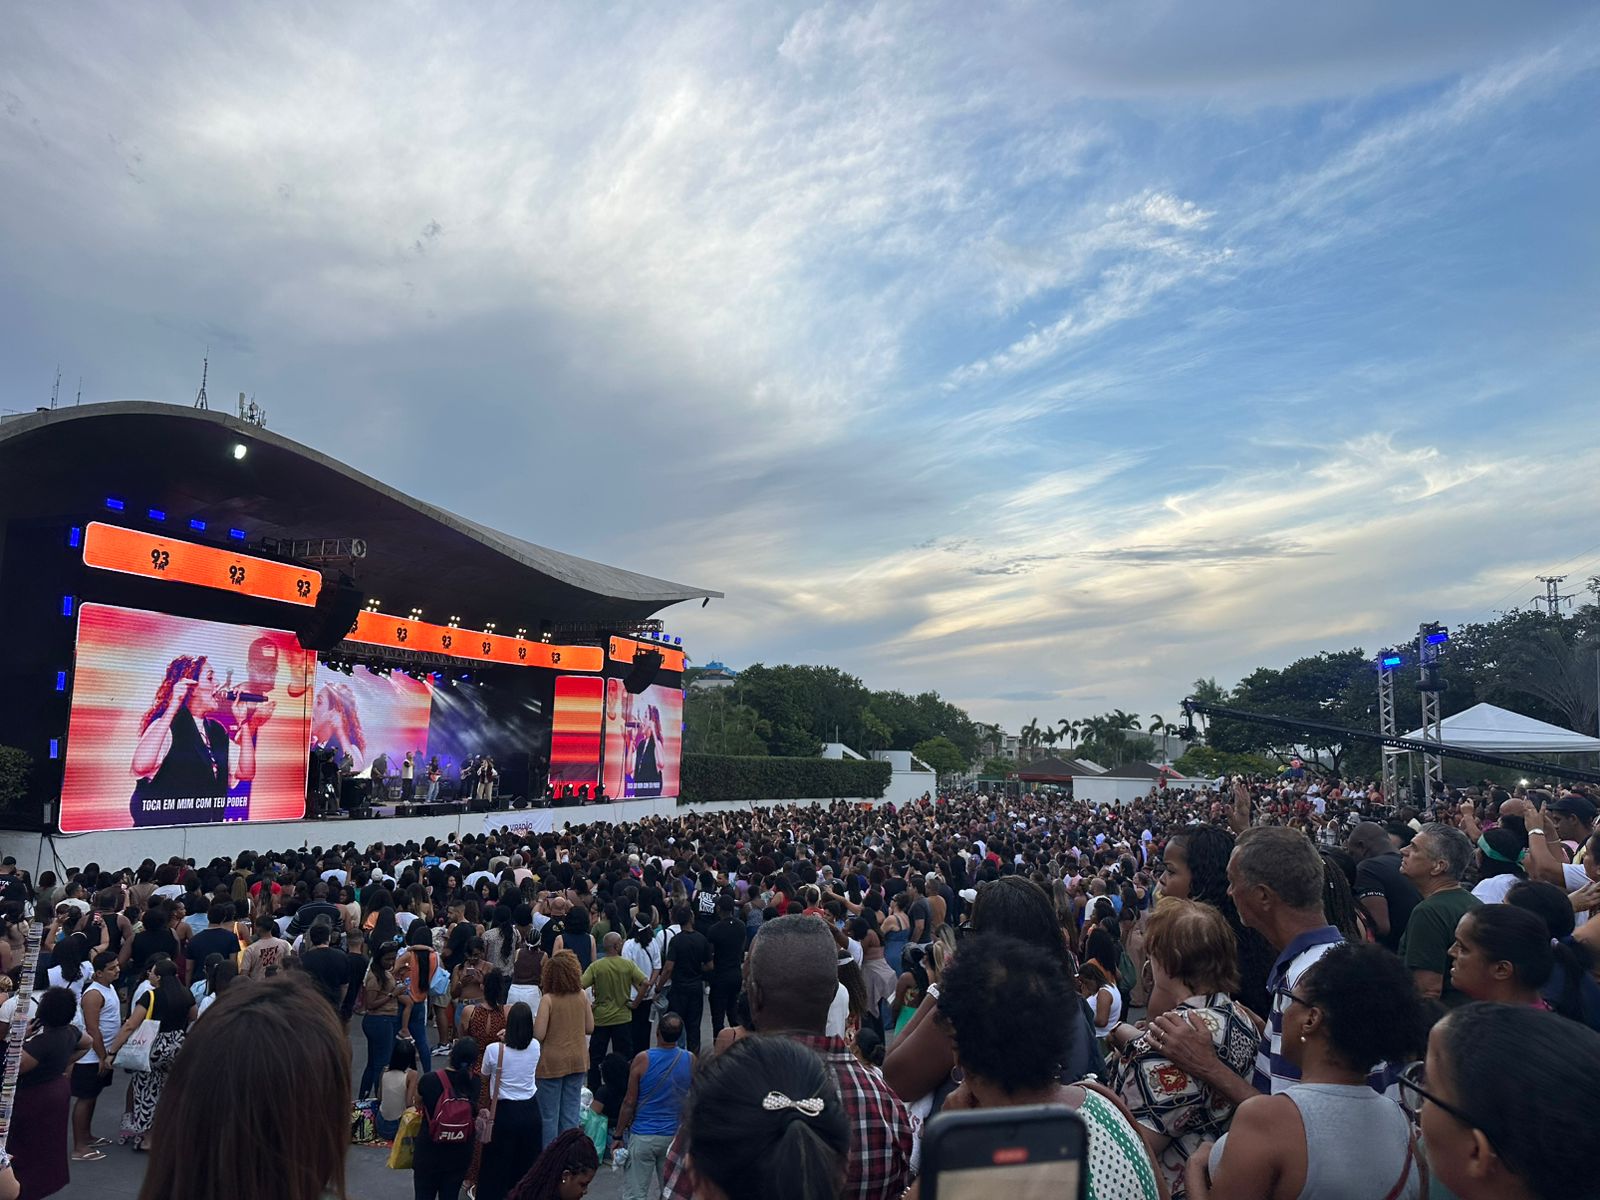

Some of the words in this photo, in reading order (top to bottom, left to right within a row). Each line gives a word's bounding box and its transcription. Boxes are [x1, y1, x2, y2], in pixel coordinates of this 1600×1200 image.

[151, 549, 170, 566] 93
[229, 565, 245, 581] 93
[297, 579, 311, 594] 93
[397, 627, 408, 640] 93
[142, 799, 161, 811] TOCA
[163, 799, 175, 810] EM
[177, 798, 194, 810] MIM
[195, 798, 212, 809] COM
[213, 797, 225, 808] TEU
[226, 796, 248, 807] PODER
[440, 1130, 465, 1140] FILA
